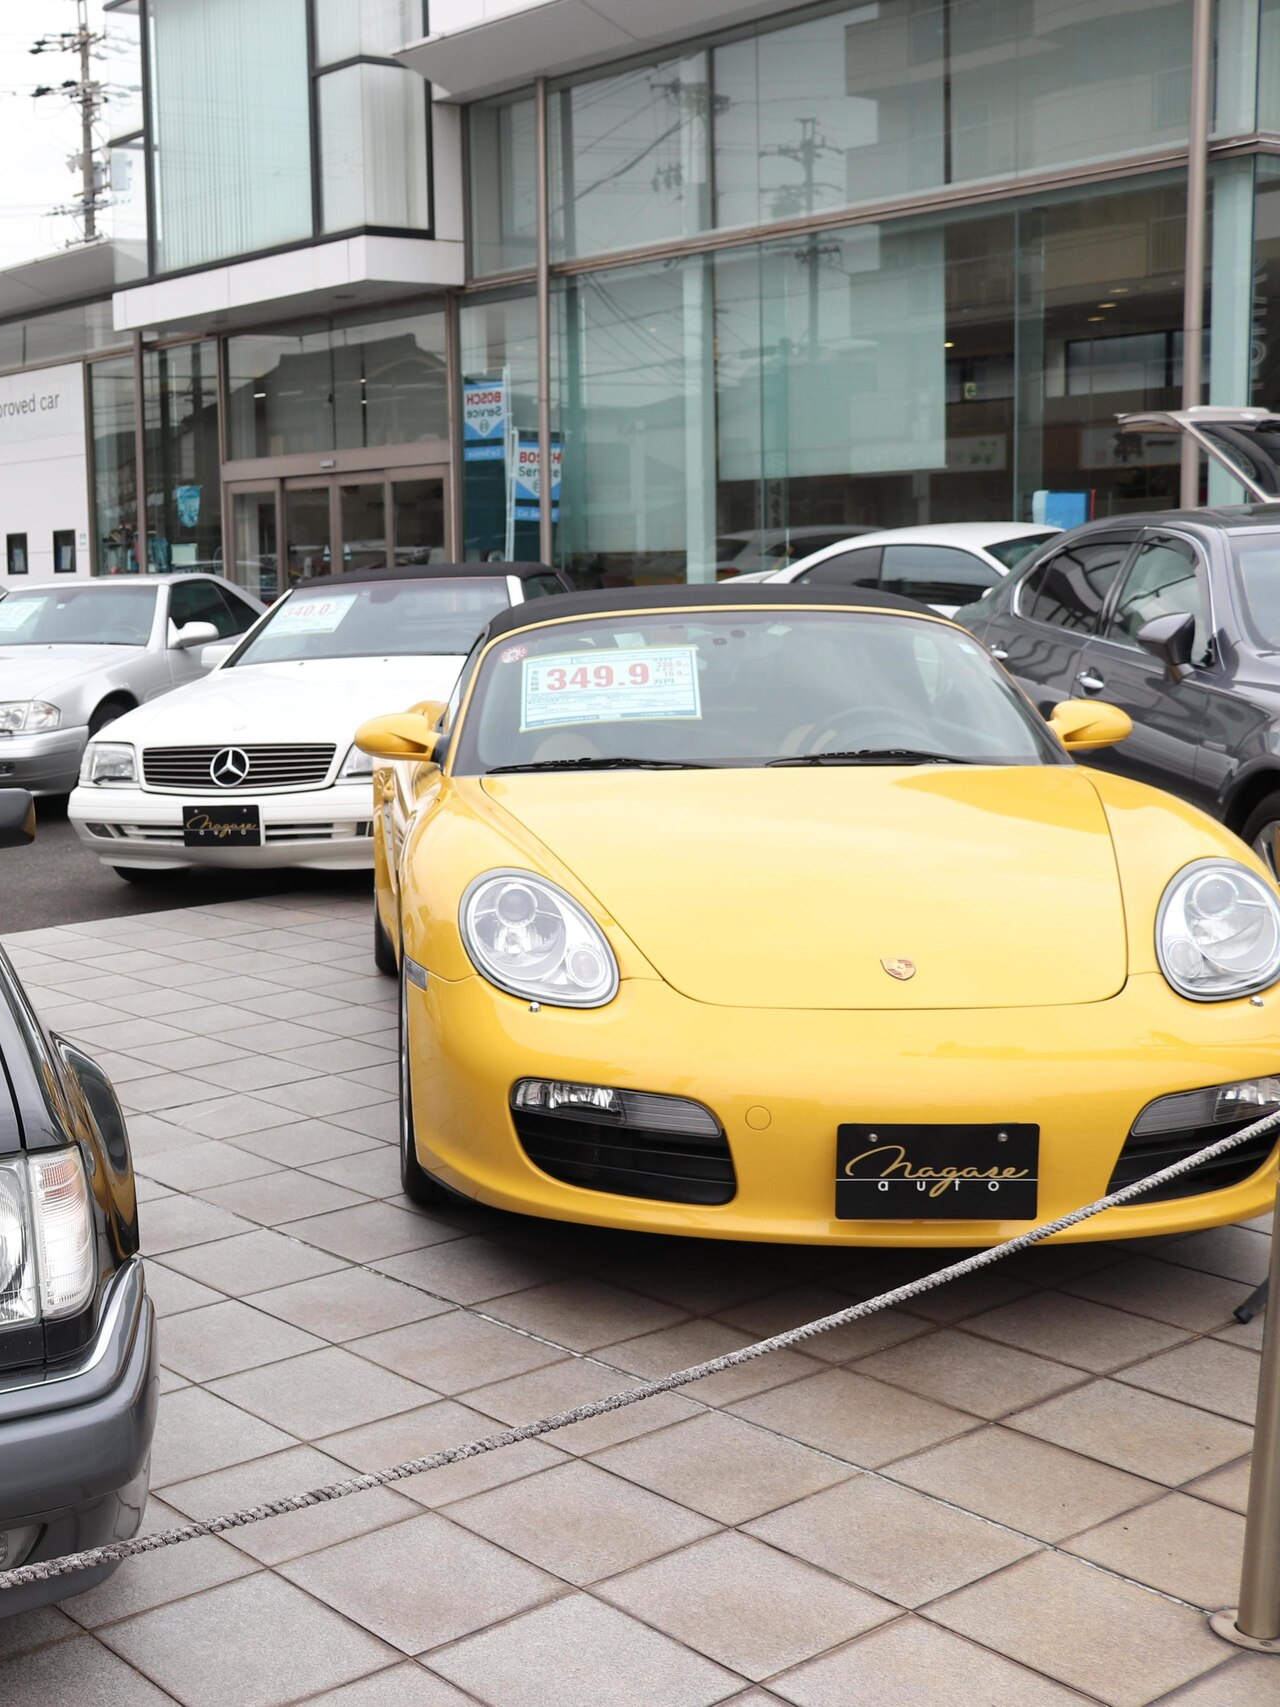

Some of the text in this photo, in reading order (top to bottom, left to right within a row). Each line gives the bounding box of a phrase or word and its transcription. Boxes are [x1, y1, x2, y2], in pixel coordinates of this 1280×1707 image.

[39, 393, 61, 411] car
[519, 451, 562, 464] BOH
[518, 465, 560, 478] Sere
[546, 662, 650, 692] 349.9
[186, 814, 257, 839] Nagase
[845, 1145, 1030, 1198] Nagase
[877, 1178, 1000, 1192] auto
